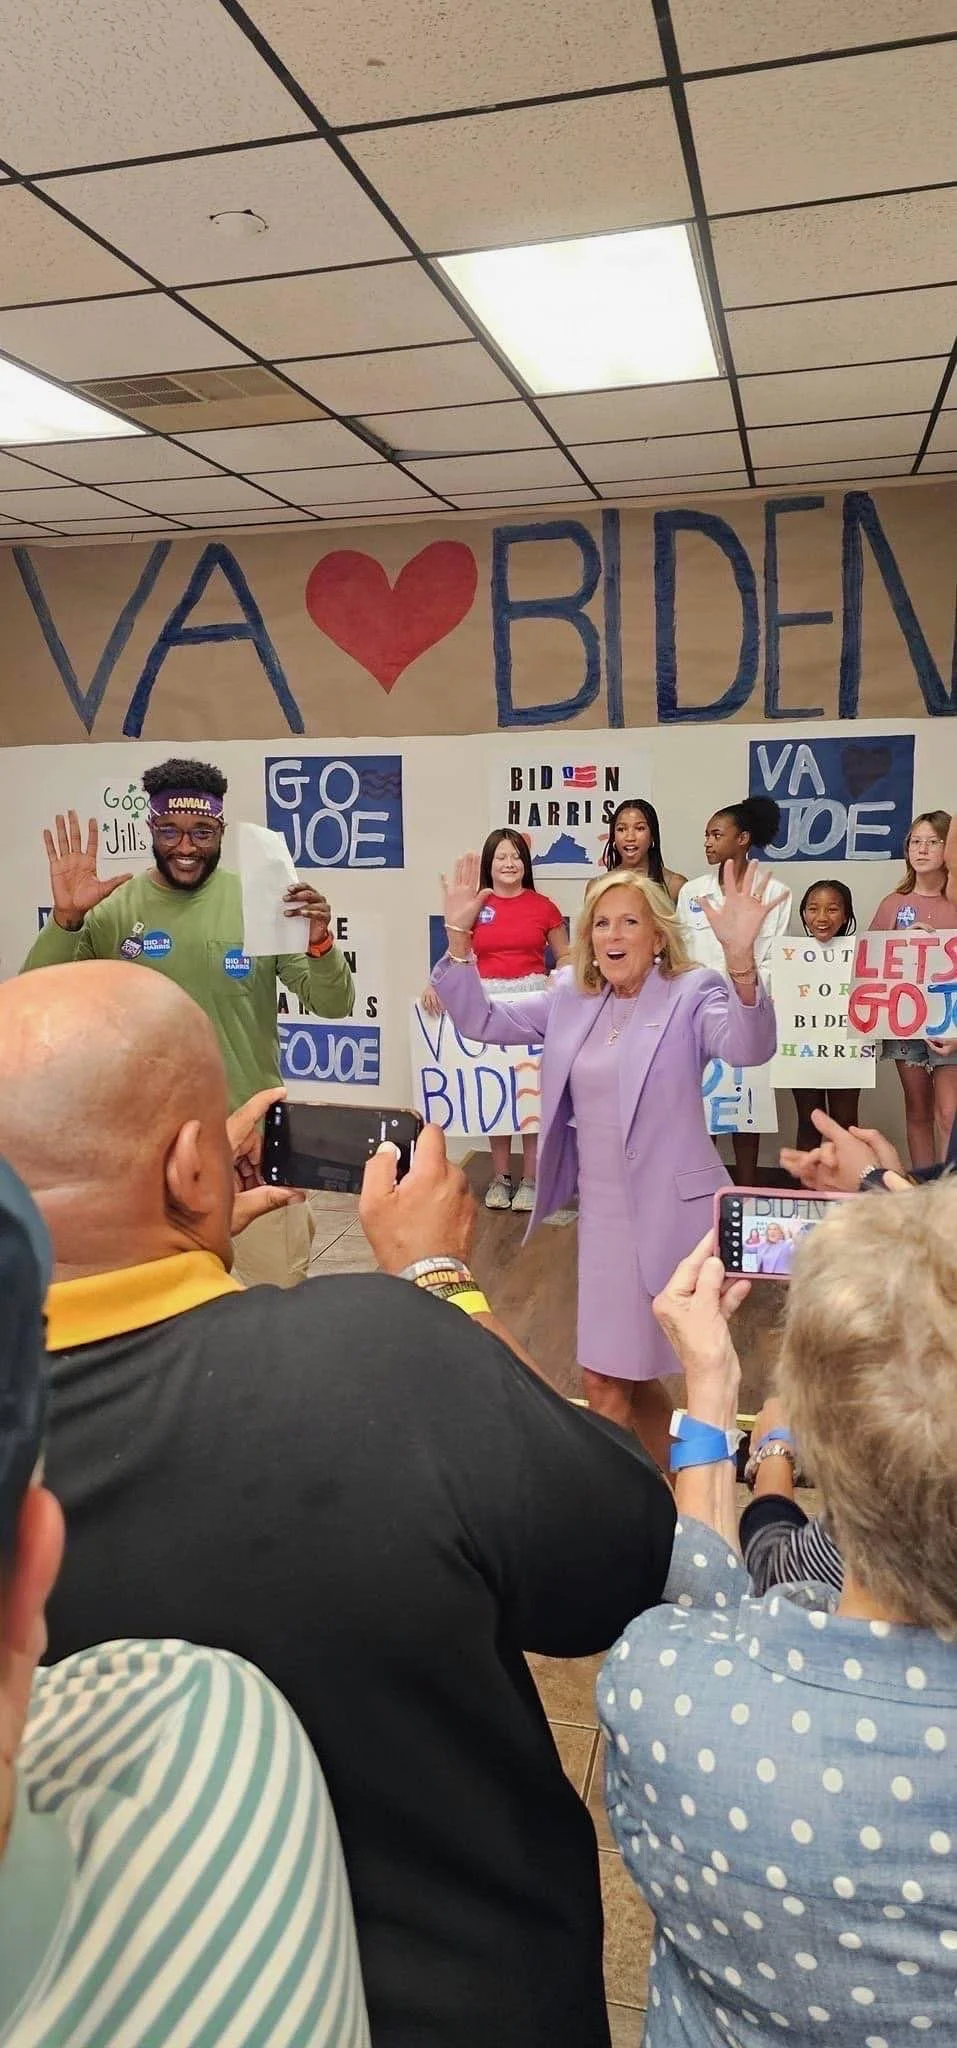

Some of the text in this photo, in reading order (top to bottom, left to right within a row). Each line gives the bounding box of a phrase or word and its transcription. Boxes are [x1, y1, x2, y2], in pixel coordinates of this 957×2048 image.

[12, 491, 957, 738] VA BIDEN
[269, 759, 360, 810] GO
[757, 743, 825, 796] VA
[168, 798, 211, 810] KAMALA
[508, 800, 616, 827] HARRIS
[763, 798, 896, 859] JOE
[106, 818, 146, 854] Jill's
[292, 808, 389, 866] JOE
[782, 948, 853, 963] YOUT
[855, 937, 957, 985] LETS
[848, 983, 927, 1037] GO
[782, 1044, 876, 1058] HARRIS!
